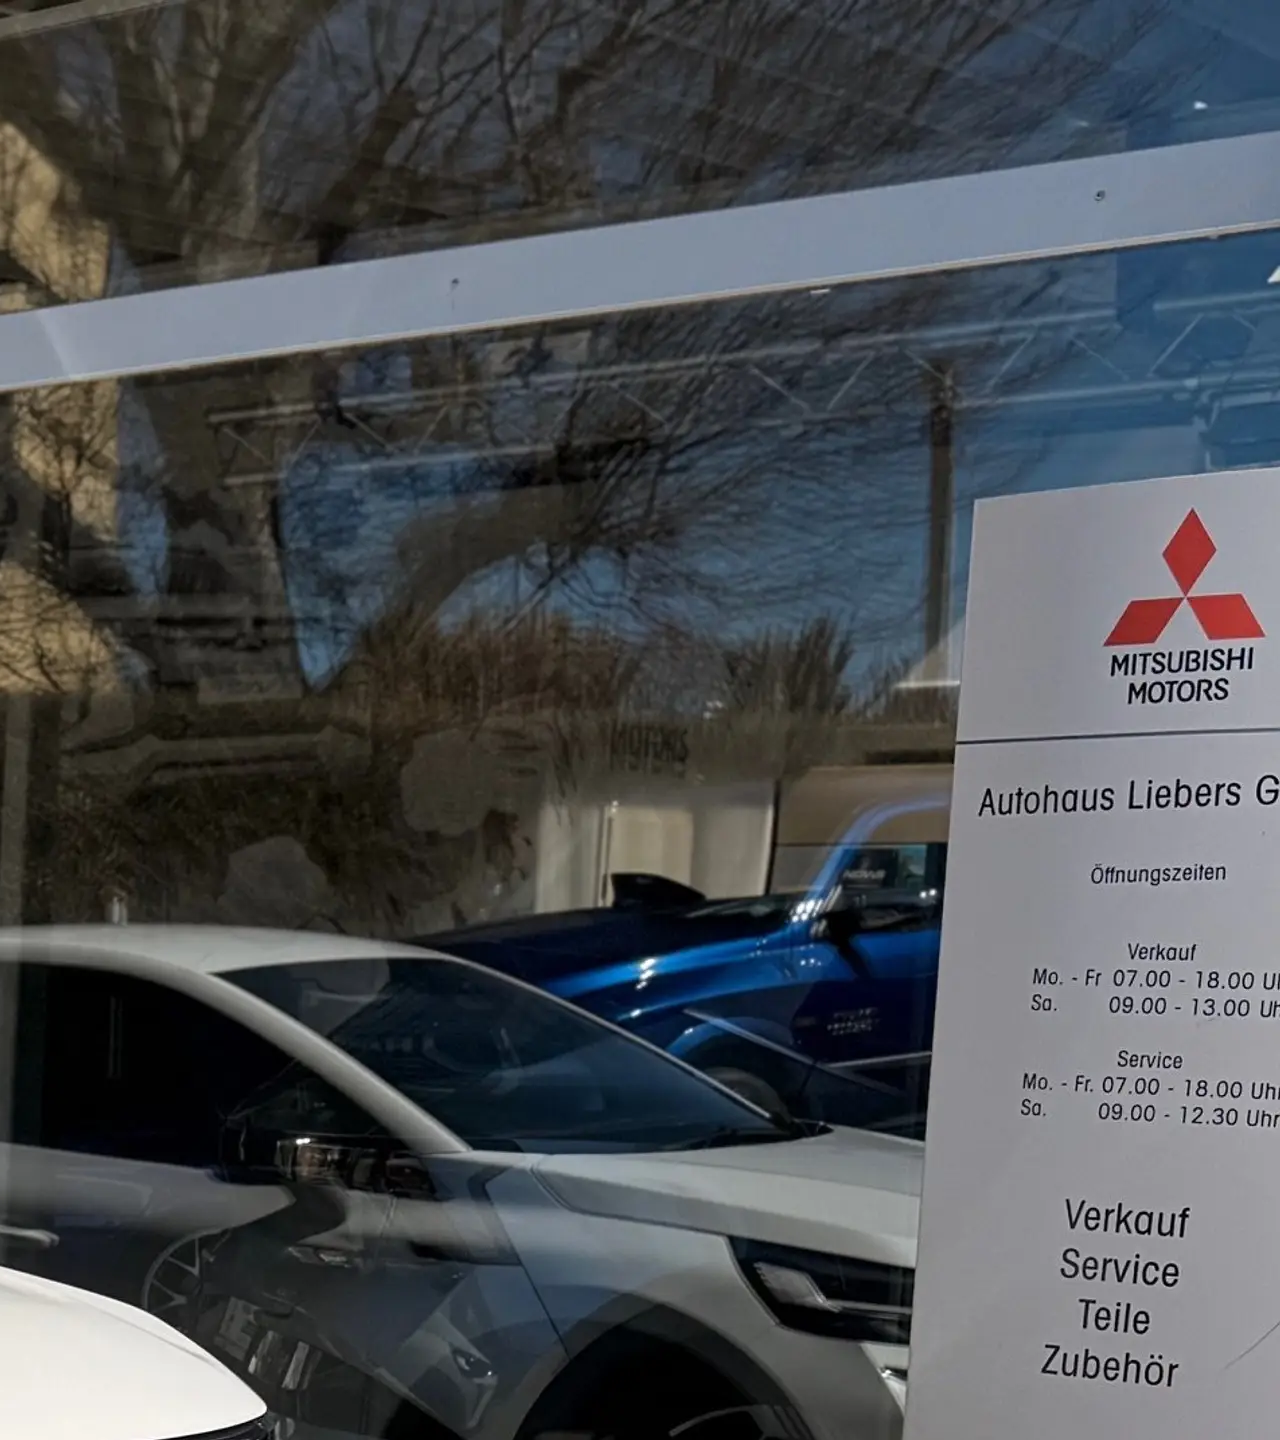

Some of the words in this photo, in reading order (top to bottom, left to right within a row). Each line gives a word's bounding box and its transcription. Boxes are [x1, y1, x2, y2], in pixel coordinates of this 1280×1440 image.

[1110, 647, 1254, 677] MITSUBISHI
[1127, 678, 1229, 705] MOTORS
[978, 784, 1115, 818] Autohaus
[1128, 778, 1241, 810] Liebers
[1091, 863, 1227, 886] Öffnungszeiten
[1127, 943, 1197, 962] Verkauf
[1032, 968, 1063, 986] Mo.
[1085, 968, 1102, 986] Fr
[1113, 969, 1171, 988] 07.00
[1196, 971, 1255, 990] 18.00
[1263, 972, 1280, 990] U
[1031, 993, 1058, 1012] Sa.
[1109, 996, 1167, 1015] 09.00
[1192, 998, 1251, 1017] 13.00
[1117, 1050, 1183, 1070] Service
[1022, 1073, 1053, 1091] Mo.
[1074, 1074, 1094, 1092] Fr.
[1102, 1075, 1160, 1096] 07.00
[1185, 1079, 1243, 1099] 18.00
[1020, 1099, 1047, 1117] Sa.
[1098, 1102, 1156, 1122] 09.00
[1181, 1106, 1239, 1126] 12.30
[1246, 1109, 1280, 1128] Uhr
[1065, 1198, 1191, 1238] Verkauf
[1060, 1248, 1180, 1287] Service
[1078, 1298, 1150, 1335] Teile
[1041, 1344, 1179, 1387] Zubehör
